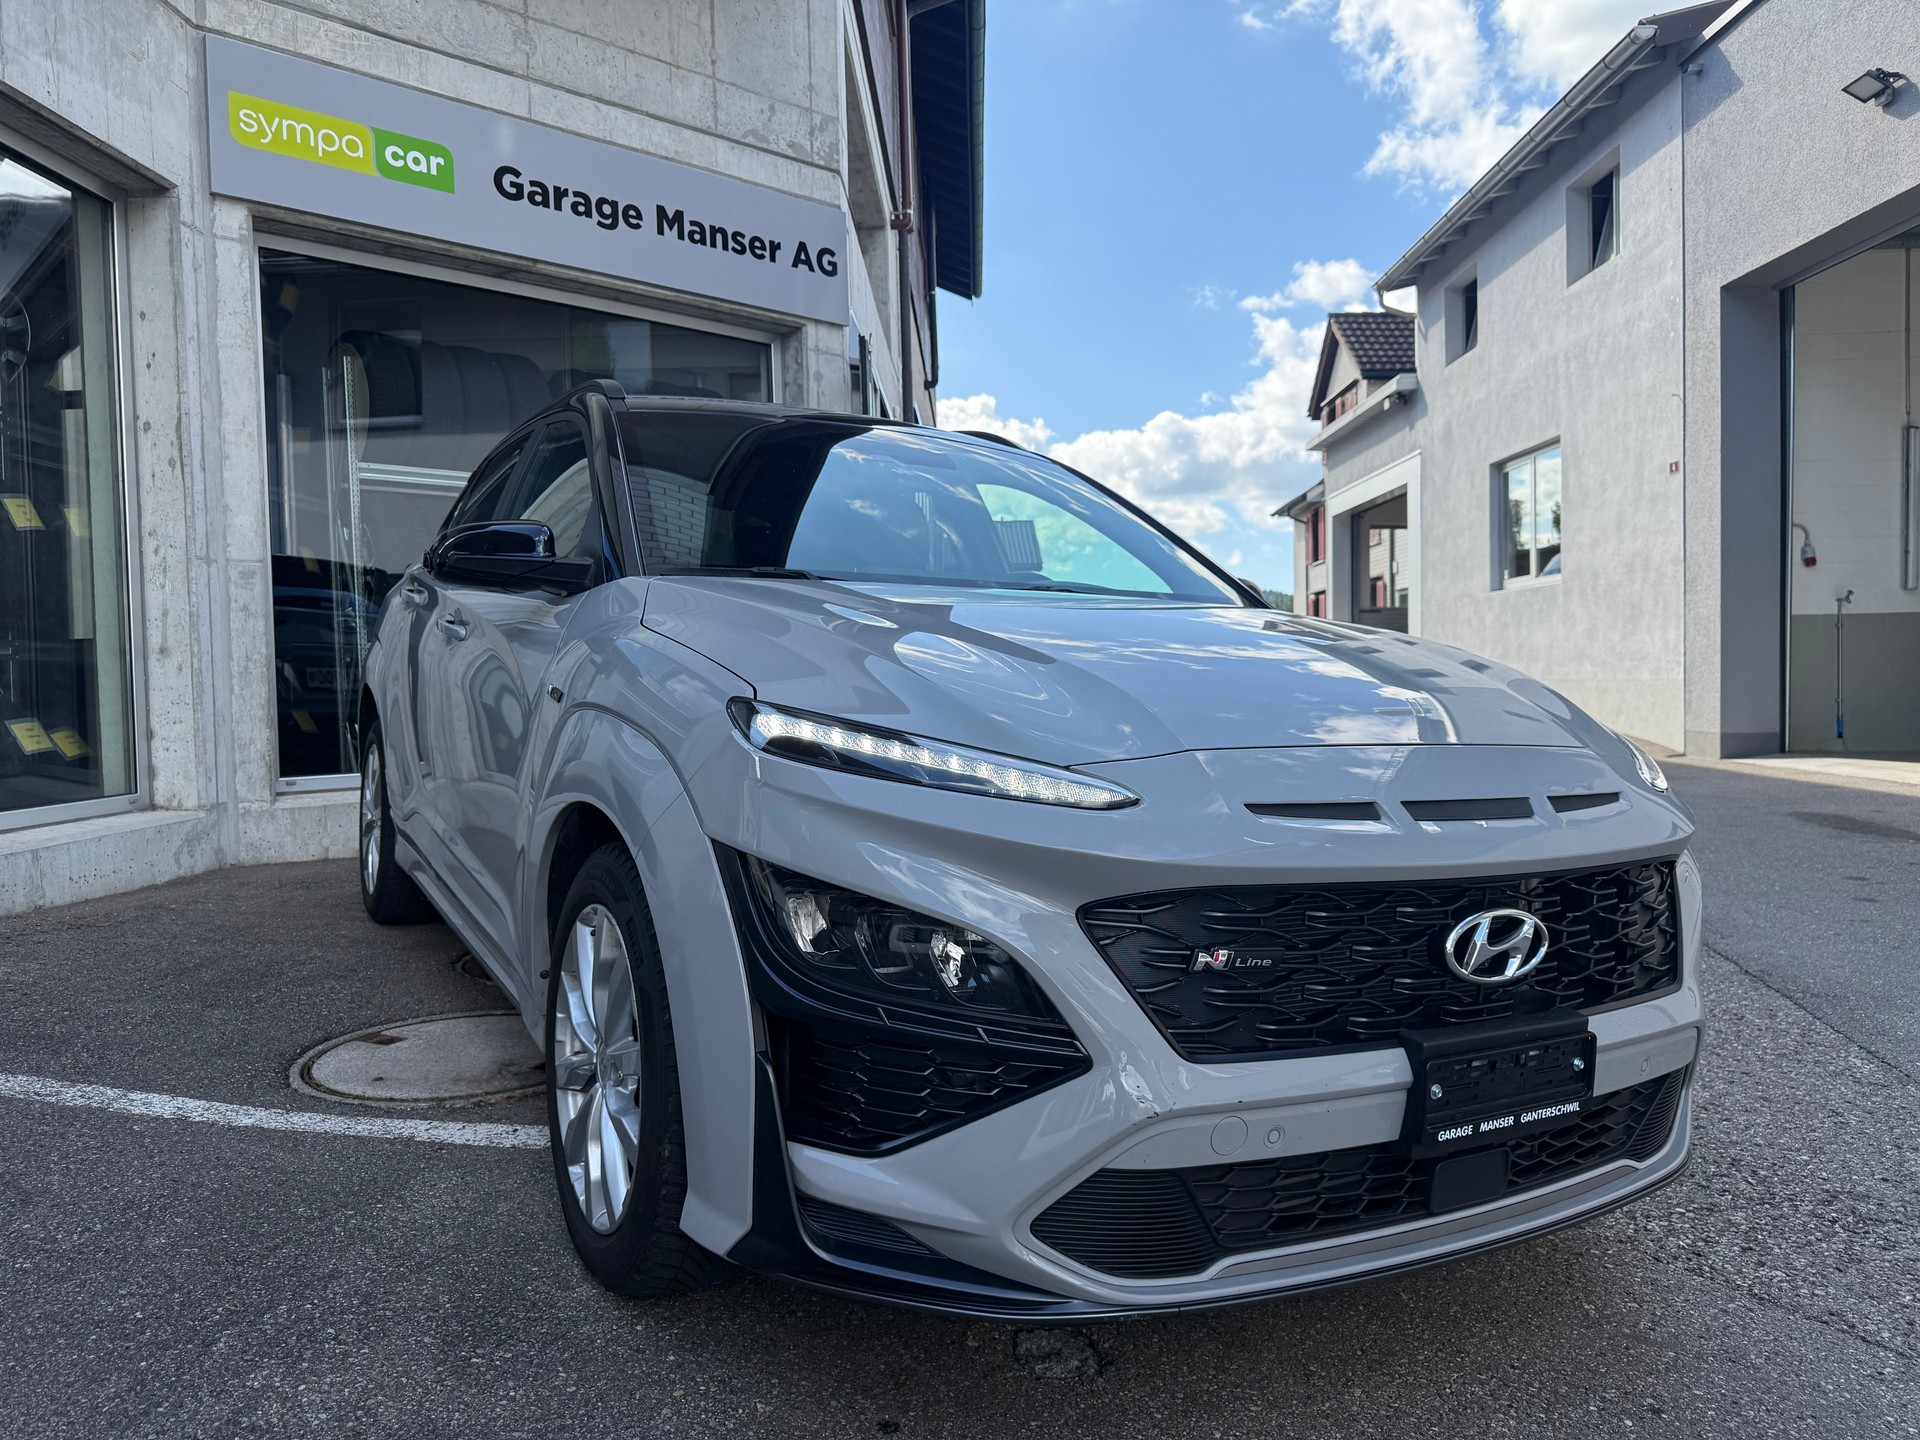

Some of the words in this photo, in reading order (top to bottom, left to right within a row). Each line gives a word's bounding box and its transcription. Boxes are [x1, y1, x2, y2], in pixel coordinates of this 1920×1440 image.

[238, 108, 364, 158] sympa
[384, 145, 445, 176] car
[493, 165, 644, 231] Garage
[656, 204, 781, 264] Manser
[791, 241, 838, 278] AG
[1235, 955, 1272, 967] Line
[1437, 1124, 1474, 1142] GARAGE
[1479, 1115, 1515, 1133] MANSER
[1520, 1101, 1581, 1124] GANTERSCHWIL
